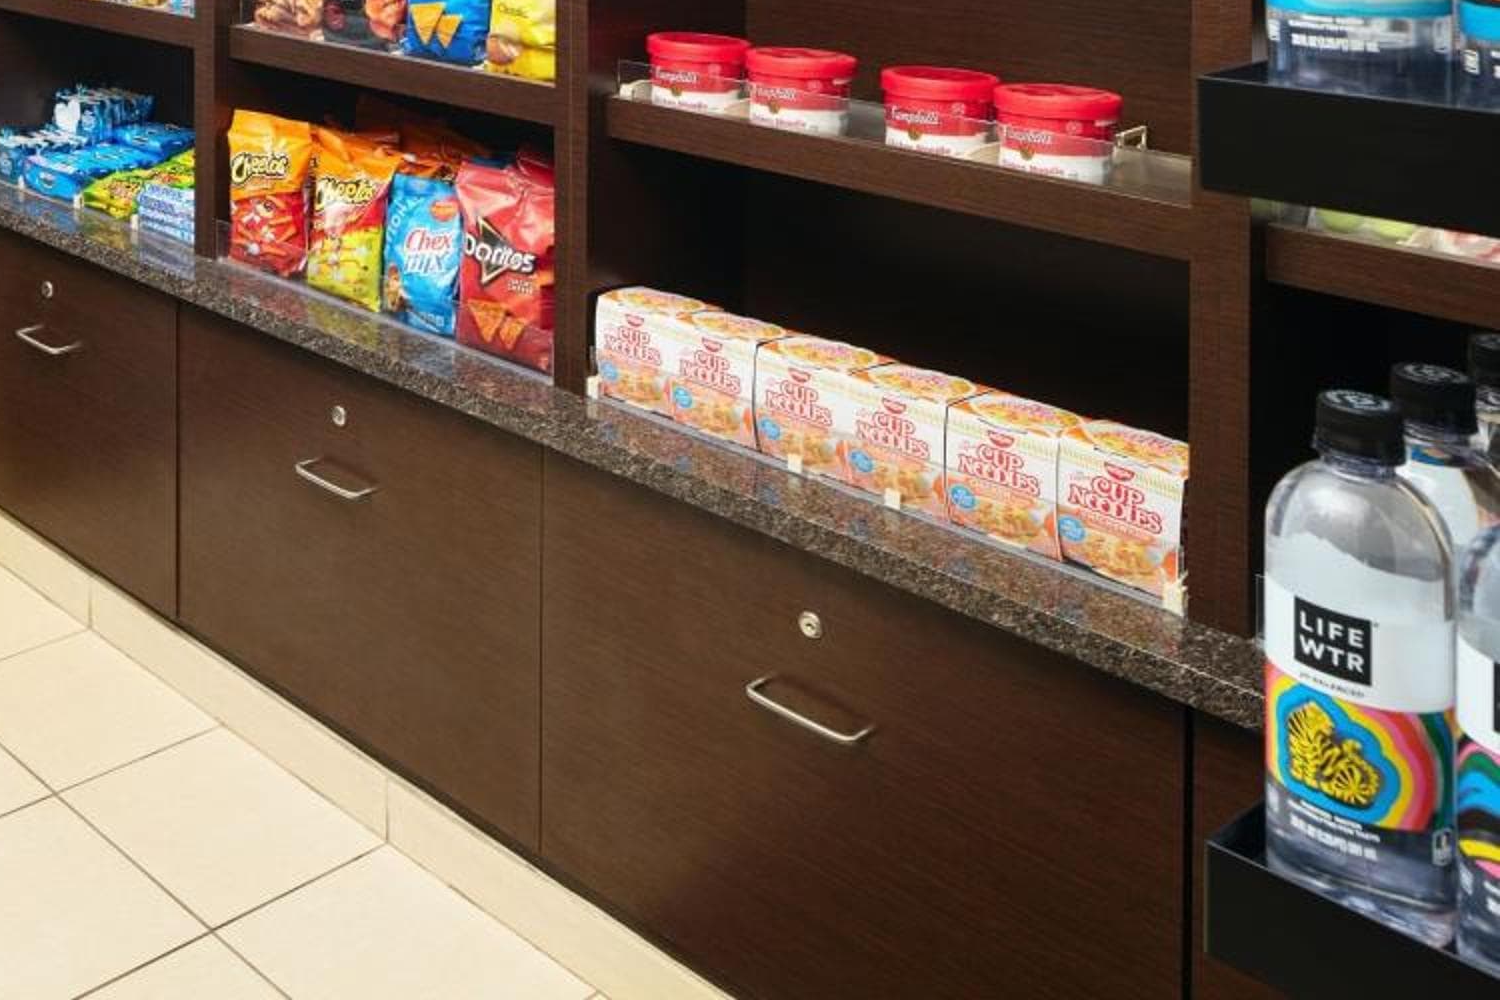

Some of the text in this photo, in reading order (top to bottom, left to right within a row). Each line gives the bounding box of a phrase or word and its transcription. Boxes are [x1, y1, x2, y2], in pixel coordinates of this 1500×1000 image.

[406, 228, 453, 252] Chex
[465, 233, 537, 273] Doritos
[781, 379, 819, 402] CUP
[855, 420, 930, 459] NOODLES
[872, 411, 916, 437] CUP
[958, 453, 1041, 497] NOODLES
[978, 443, 1024, 471] CUP
[1068, 483, 1163, 535] NOODLES
[1091, 476, 1145, 506] CUP
[1300, 611, 1365, 649] LIFE
[1299, 635, 1365, 674] WTR
